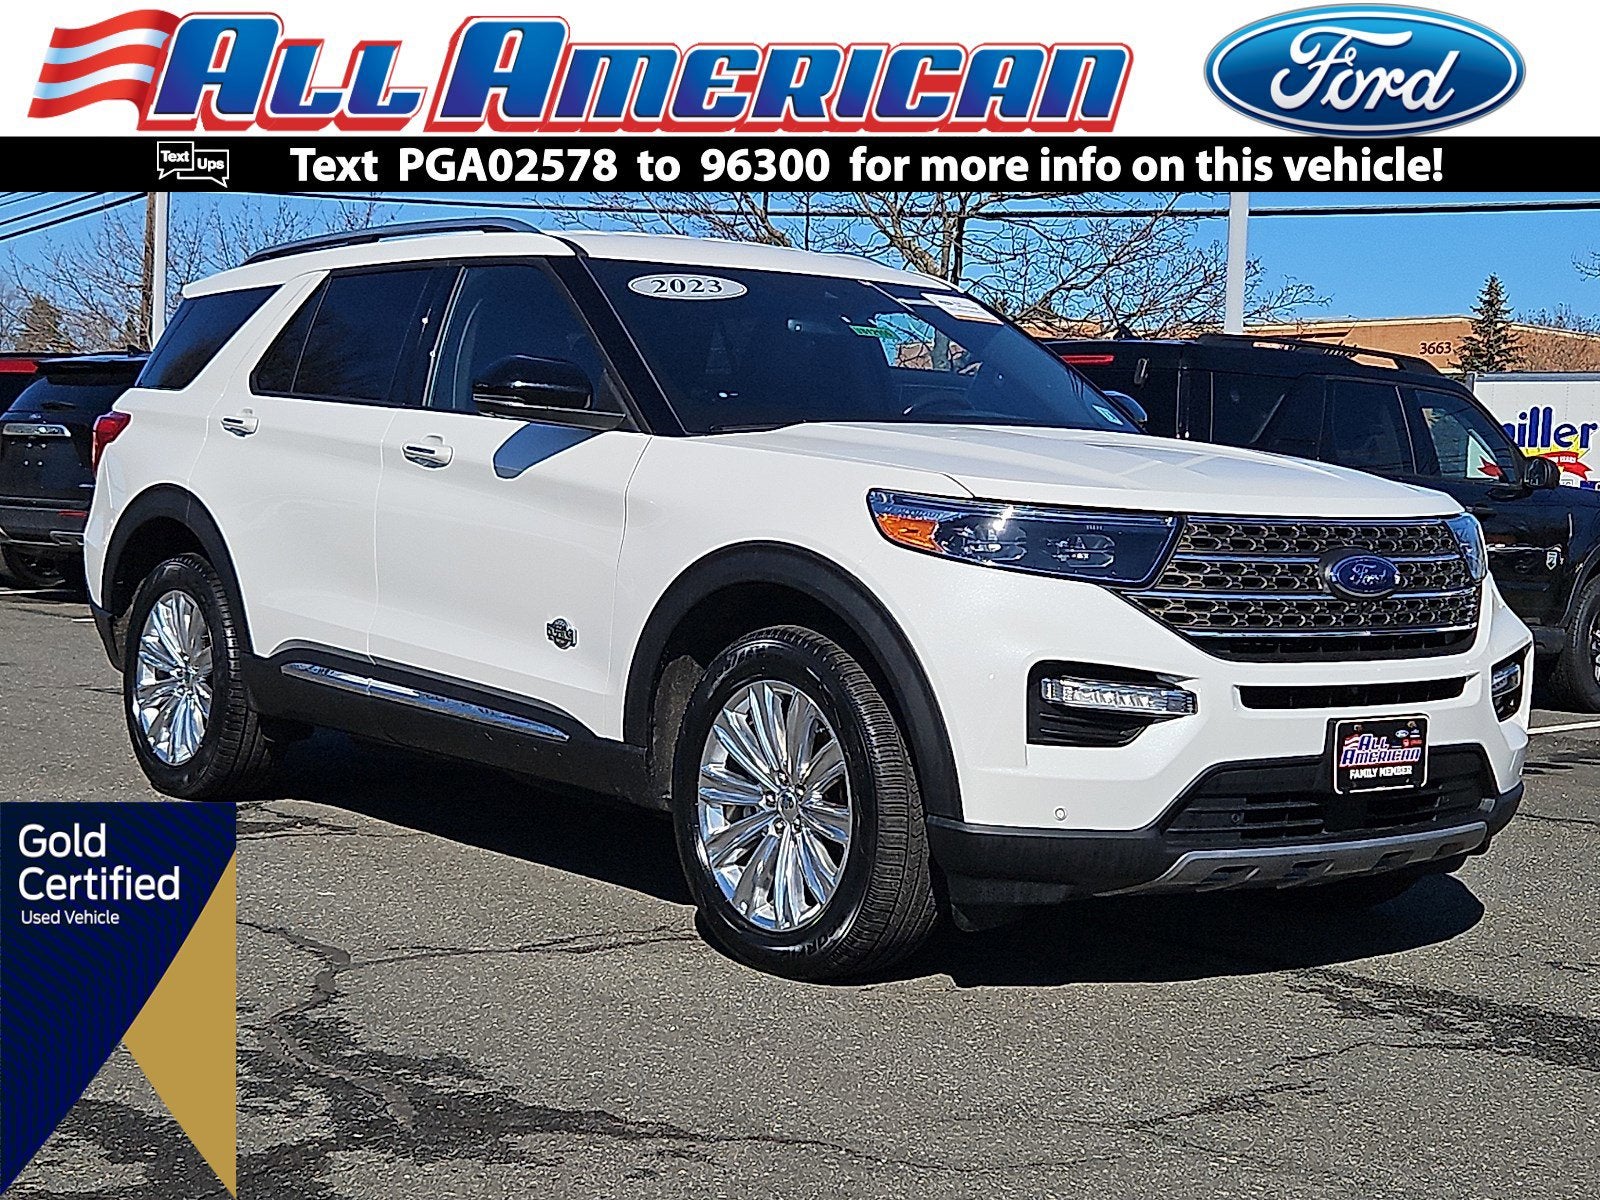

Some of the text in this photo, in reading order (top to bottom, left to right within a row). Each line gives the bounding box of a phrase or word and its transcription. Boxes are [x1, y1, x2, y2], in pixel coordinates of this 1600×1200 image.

[650, 278, 722, 293] 2023
[1419, 341, 1452, 355] 3663
[1349, 563, 1387, 586] Ford
[1349, 767, 1379, 780] FAMILY
